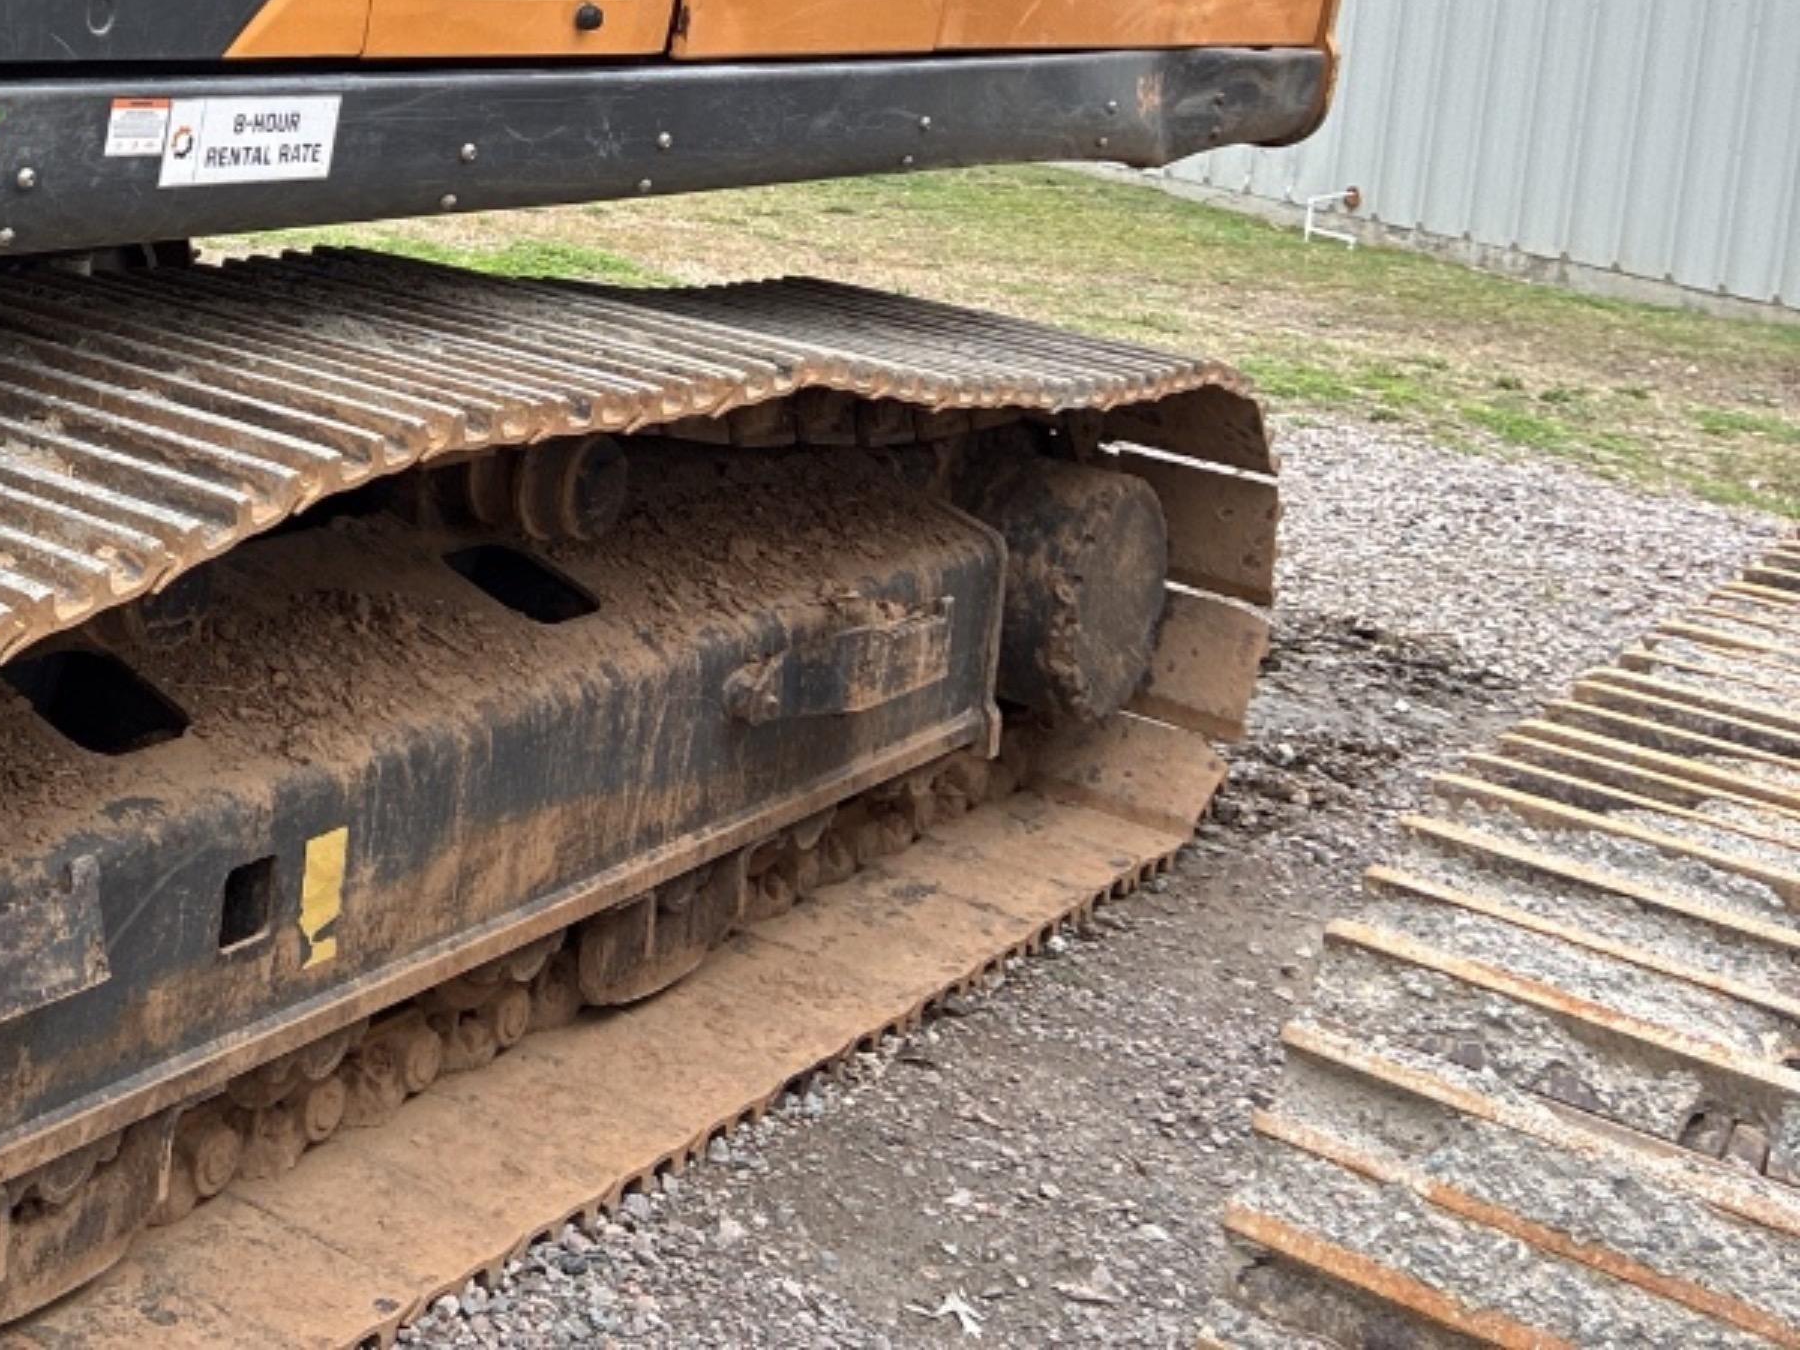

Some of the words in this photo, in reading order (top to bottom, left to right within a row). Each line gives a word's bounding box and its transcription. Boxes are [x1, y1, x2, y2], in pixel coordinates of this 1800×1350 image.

[233, 112, 301, 135] 8-HOUR
[204, 145, 271, 168] RENTAL
[278, 143, 323, 164] RATE
